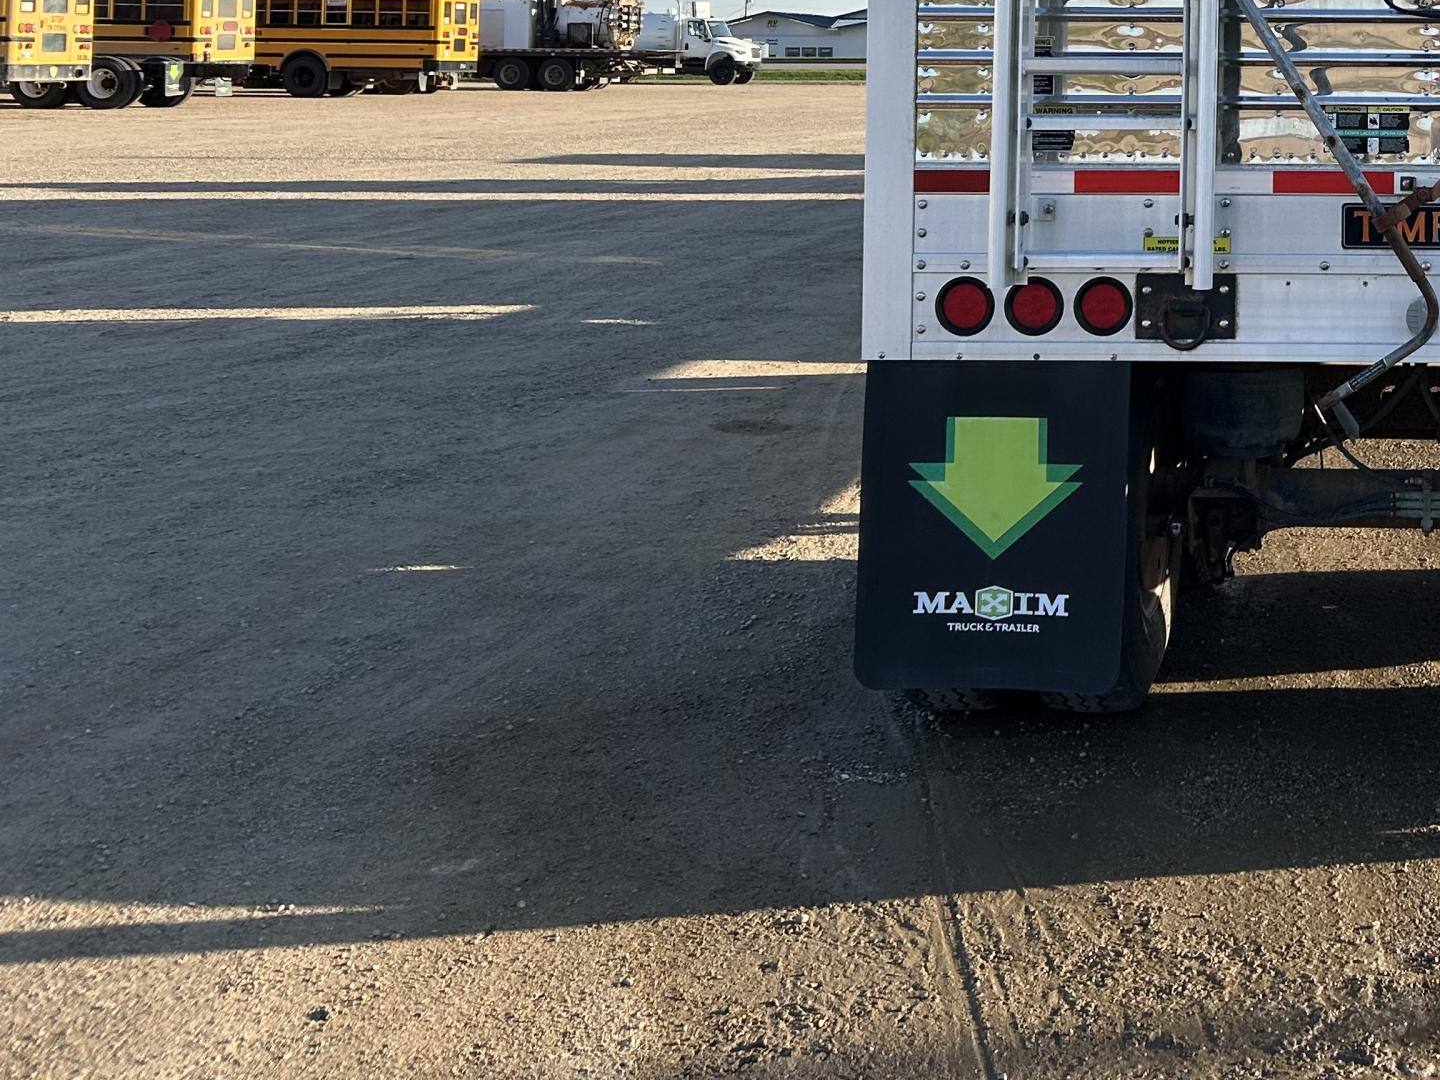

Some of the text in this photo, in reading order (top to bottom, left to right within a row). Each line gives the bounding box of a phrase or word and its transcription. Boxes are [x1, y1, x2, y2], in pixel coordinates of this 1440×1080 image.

[913, 585, 1070, 621] MAXIM
[947, 622, 984, 632] TRUCK
[994, 623, 1040, 633] TRAILER
